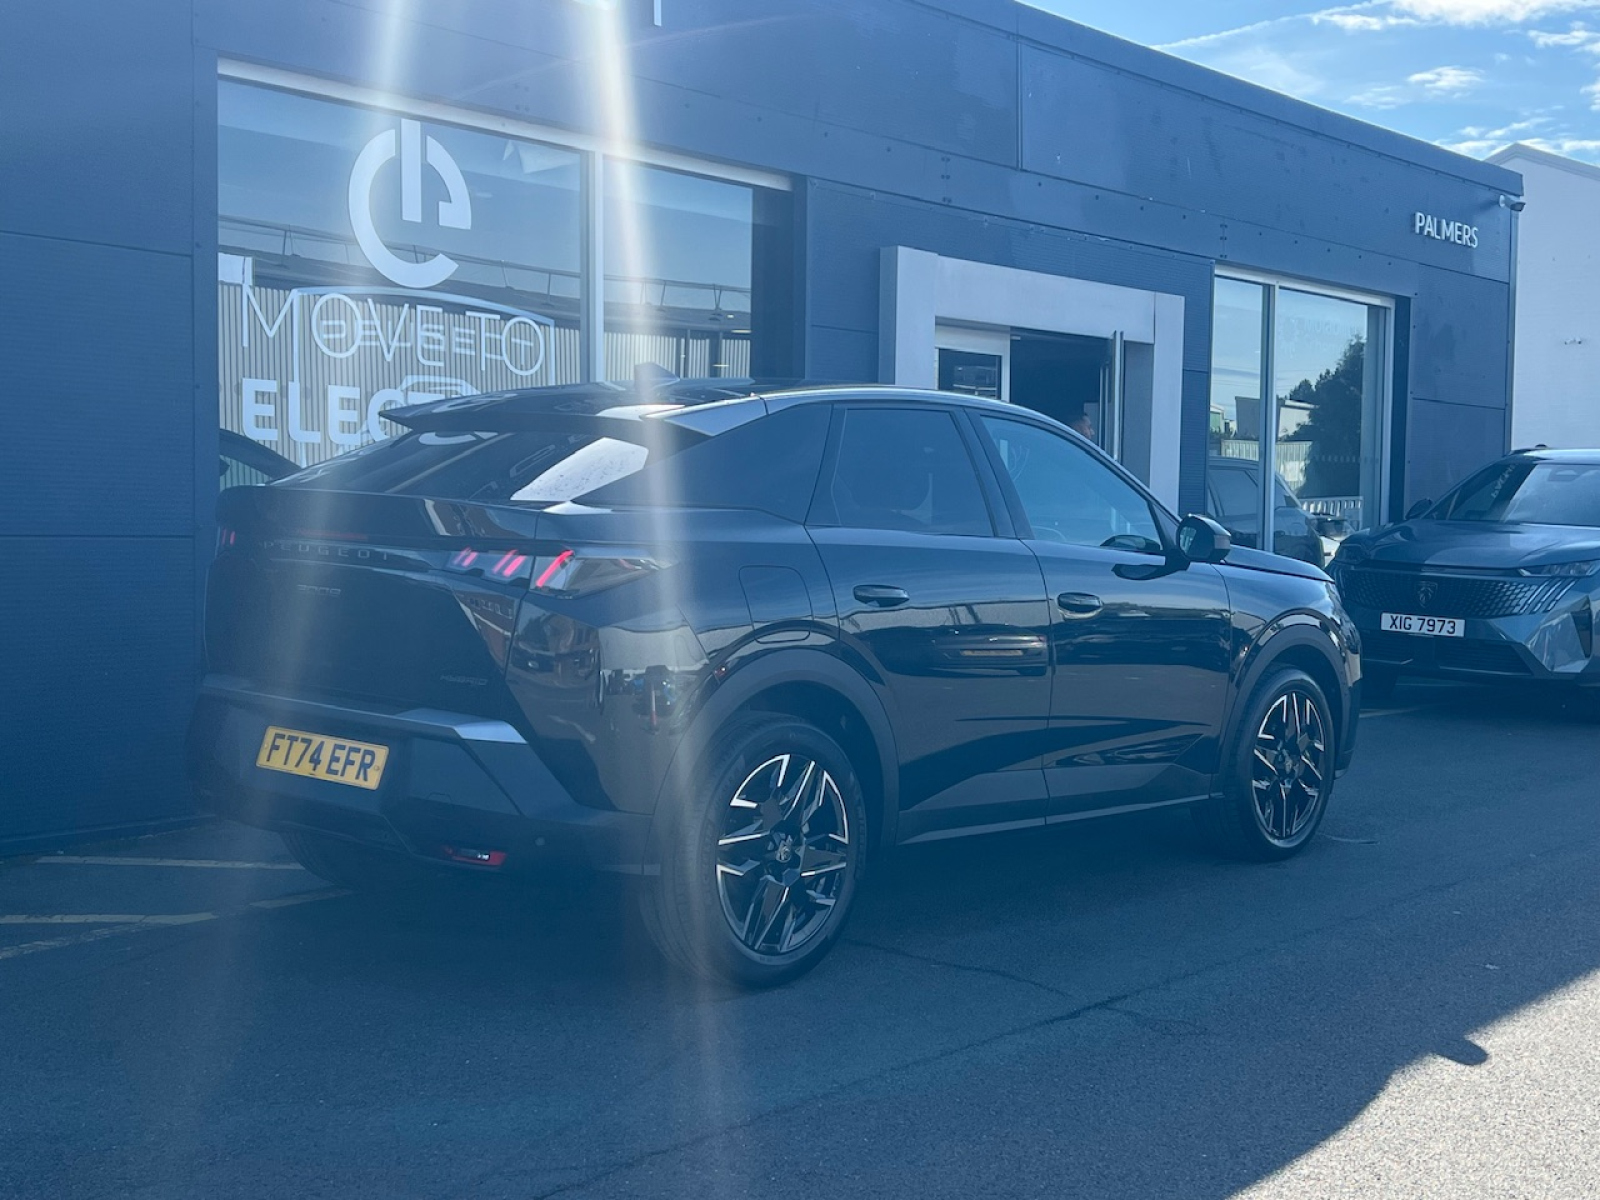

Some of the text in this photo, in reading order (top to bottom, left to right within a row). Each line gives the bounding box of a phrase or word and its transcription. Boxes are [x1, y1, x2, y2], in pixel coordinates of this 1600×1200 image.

[1414, 211, 1479, 248] PALMERS
[241, 283, 545, 376] MOVE TO
[241, 376, 446, 443] ELEC
[262, 540, 390, 561] PEUGEOT
[1389, 615, 1457, 635] XIG 7973
[265, 732, 376, 782] FT74 EFR
